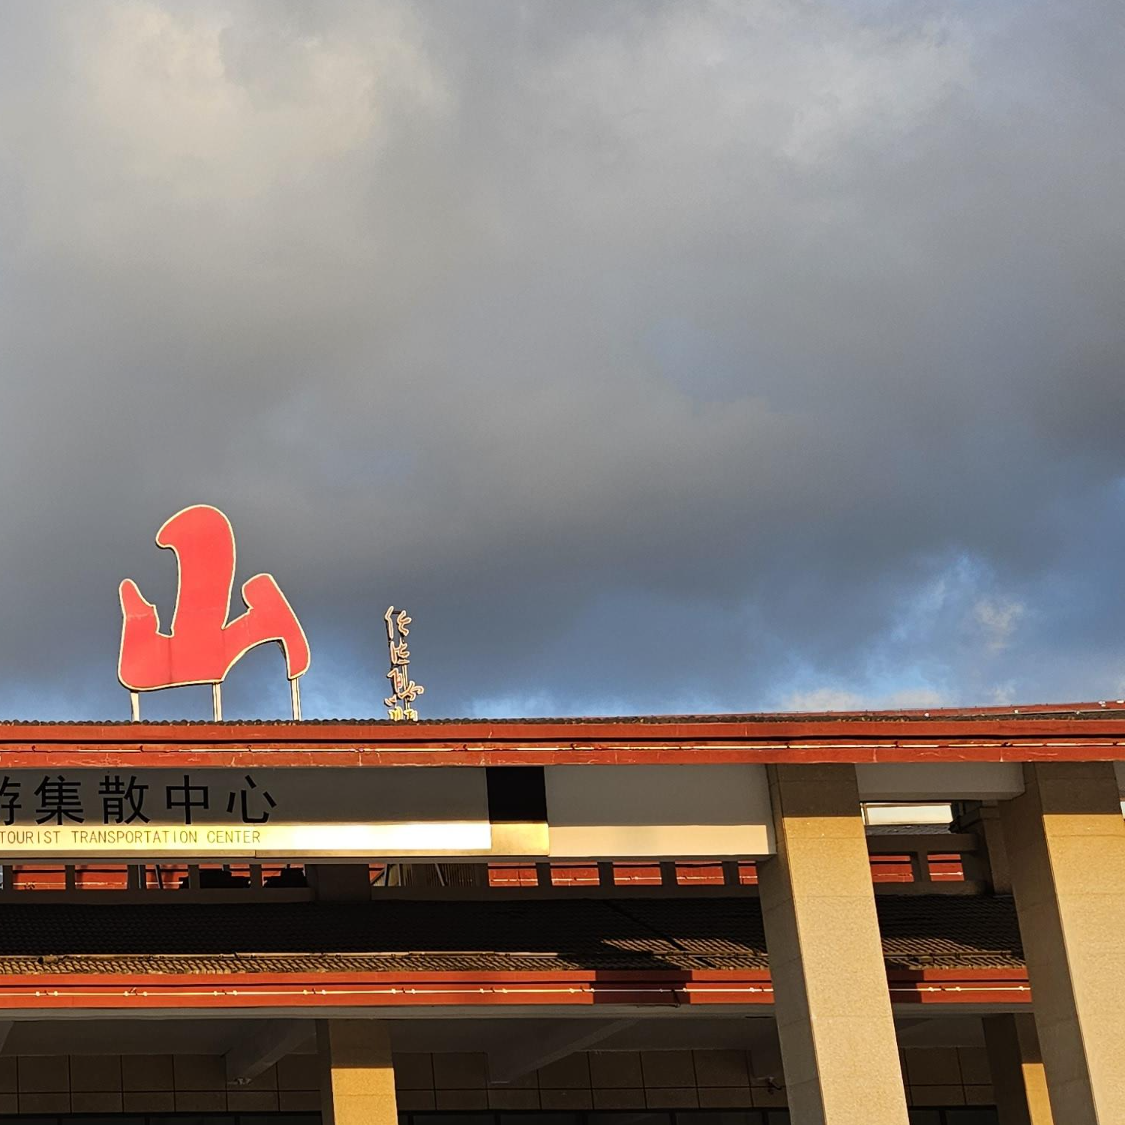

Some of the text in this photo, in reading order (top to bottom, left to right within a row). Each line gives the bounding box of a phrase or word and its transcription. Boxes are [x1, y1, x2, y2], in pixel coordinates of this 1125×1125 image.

[0, 830, 60, 844] TOURIST
[72, 830, 198, 844] TRANSPORTATION
[206, 830, 261, 844] CENTER
